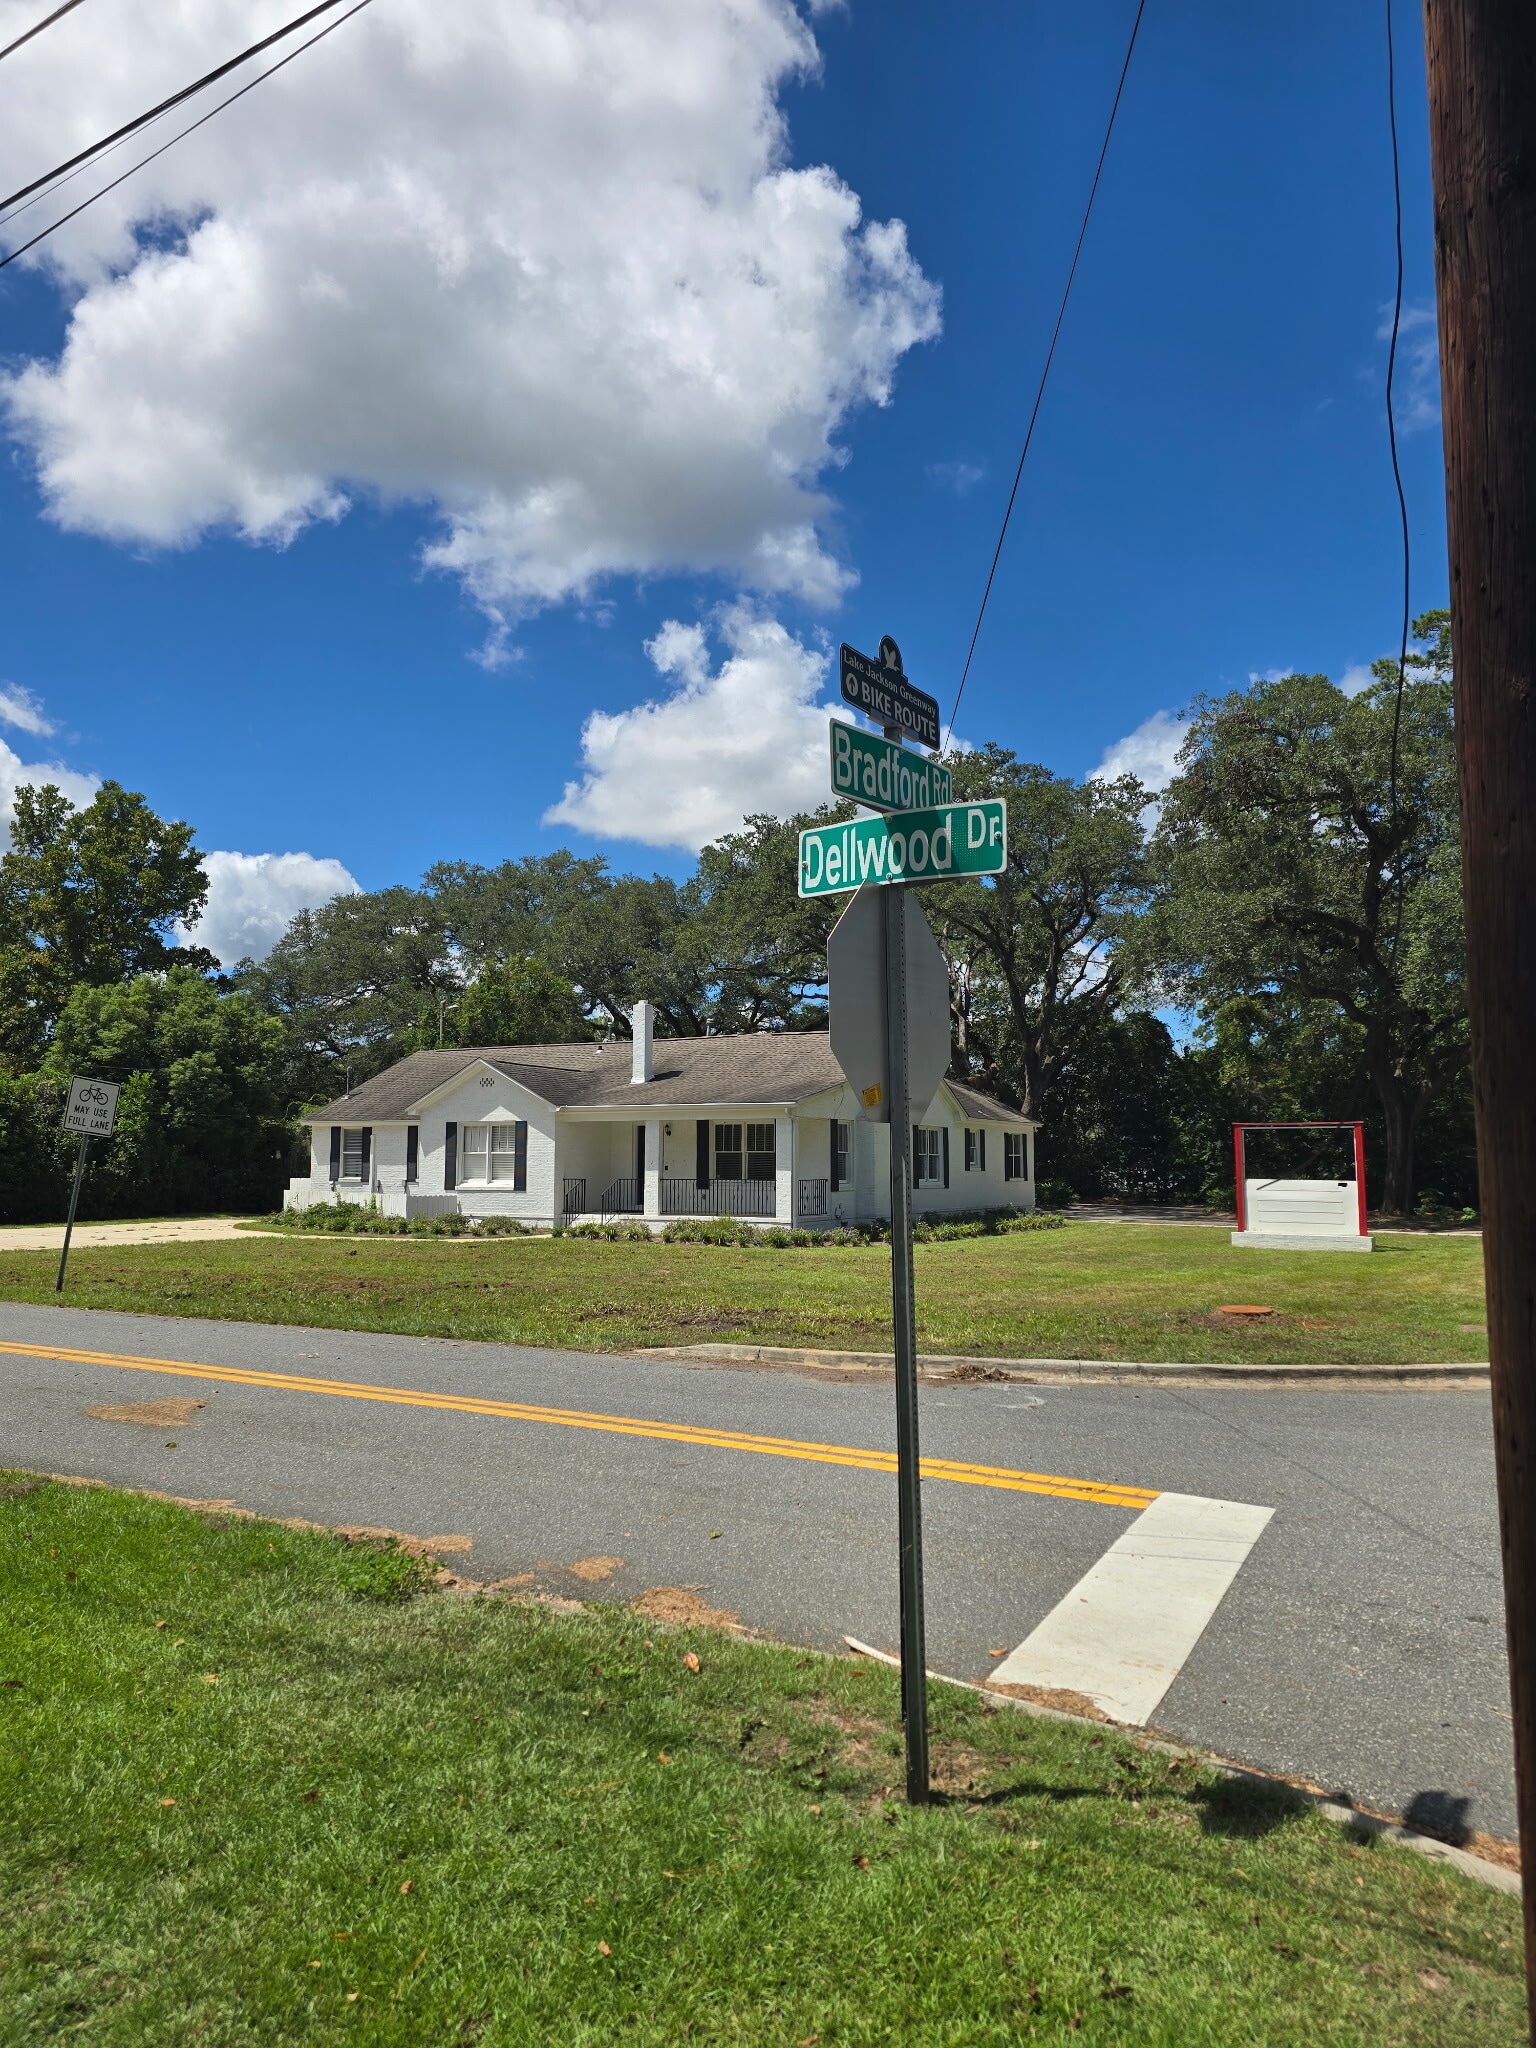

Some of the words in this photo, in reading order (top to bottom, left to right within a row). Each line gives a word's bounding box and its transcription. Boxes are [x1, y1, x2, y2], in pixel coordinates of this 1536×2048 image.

[843, 650, 864, 673] Lake
[866, 665, 898, 693] Jackson
[900, 686, 936, 718] Greenway
[861, 681, 892, 717] BIKE
[894, 700, 937, 741] ROUTE
[835, 727, 929, 809] Bradford
[933, 768, 949, 805] Rd
[805, 812, 952, 888] Dellwood
[967, 809, 1000, 849] Dr
[68, 1116, 86, 1126] FULL
[90, 1120, 109, 1130] LANE
[74, 1105, 90, 1114] MAY
[93, 1108, 108, 1118] USE
